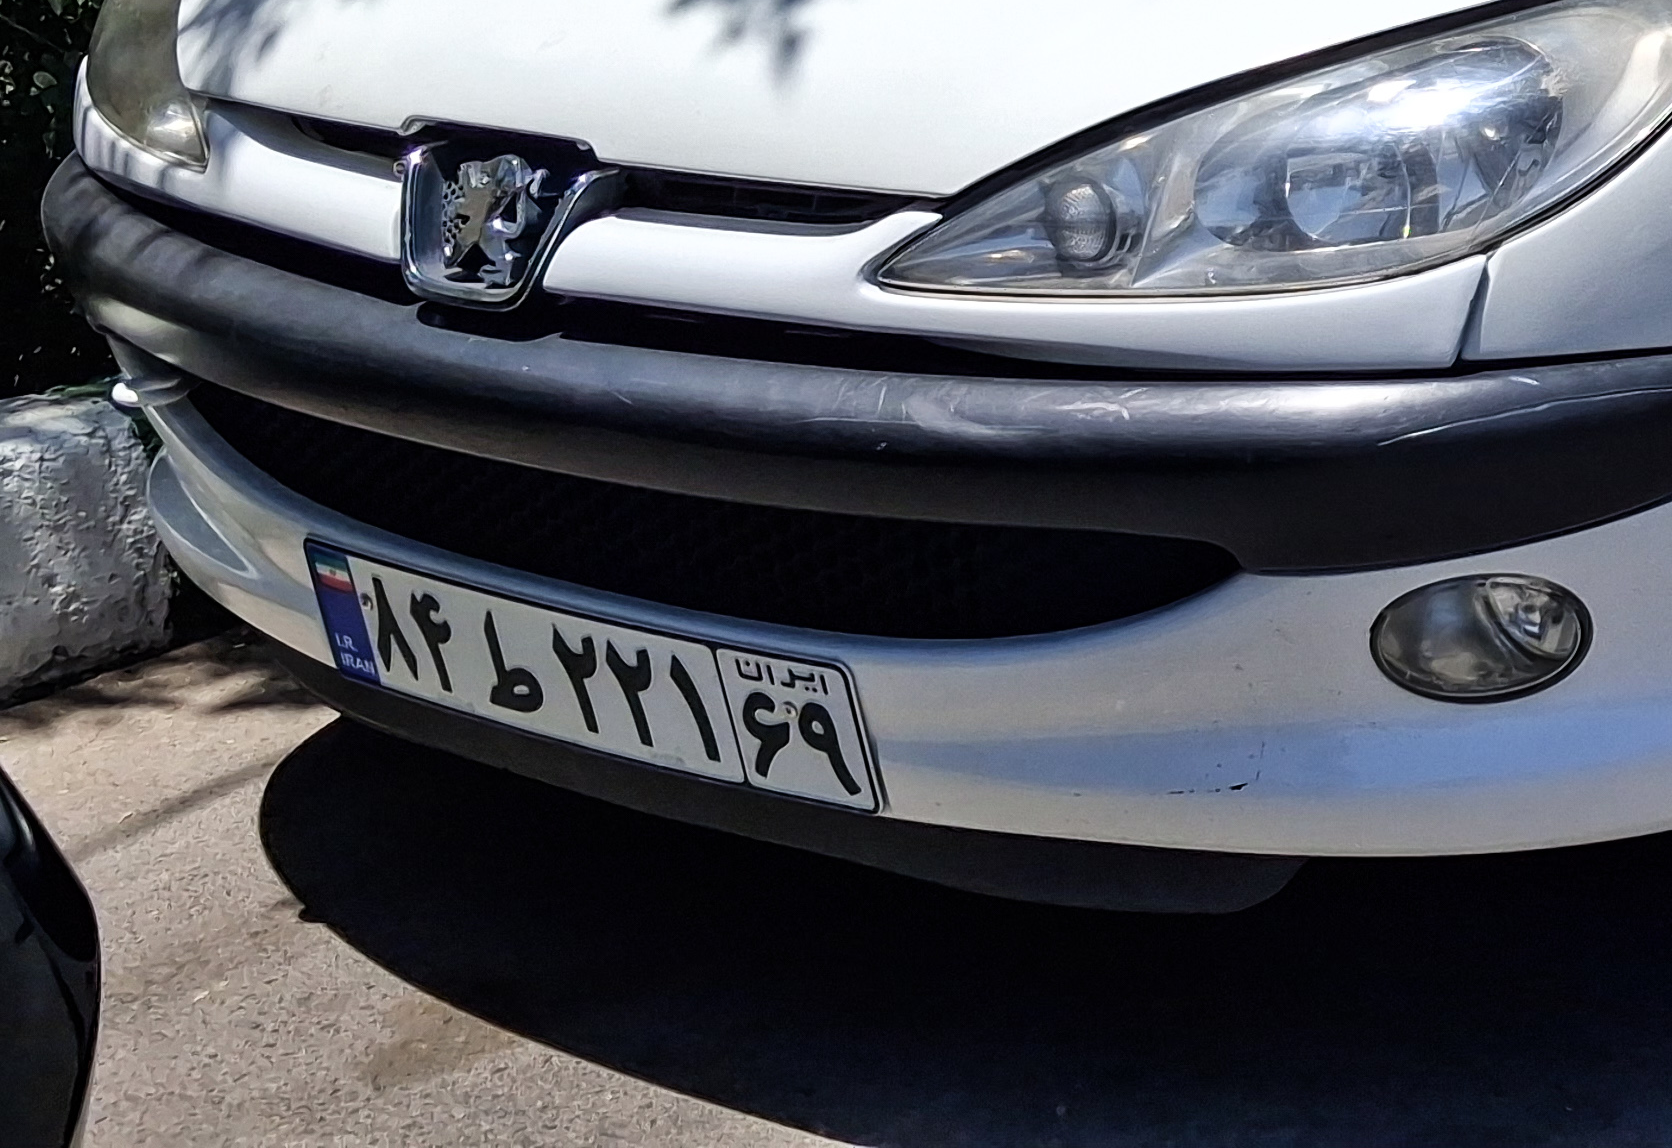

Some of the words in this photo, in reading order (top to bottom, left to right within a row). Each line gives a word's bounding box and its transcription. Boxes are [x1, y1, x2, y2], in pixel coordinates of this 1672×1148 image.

[340, 651, 376, 676] IRAN
[483, 608, 544, 713] ط
[735, 658, 829, 696] ایران
[742, 691, 862, 796] ۶۹
